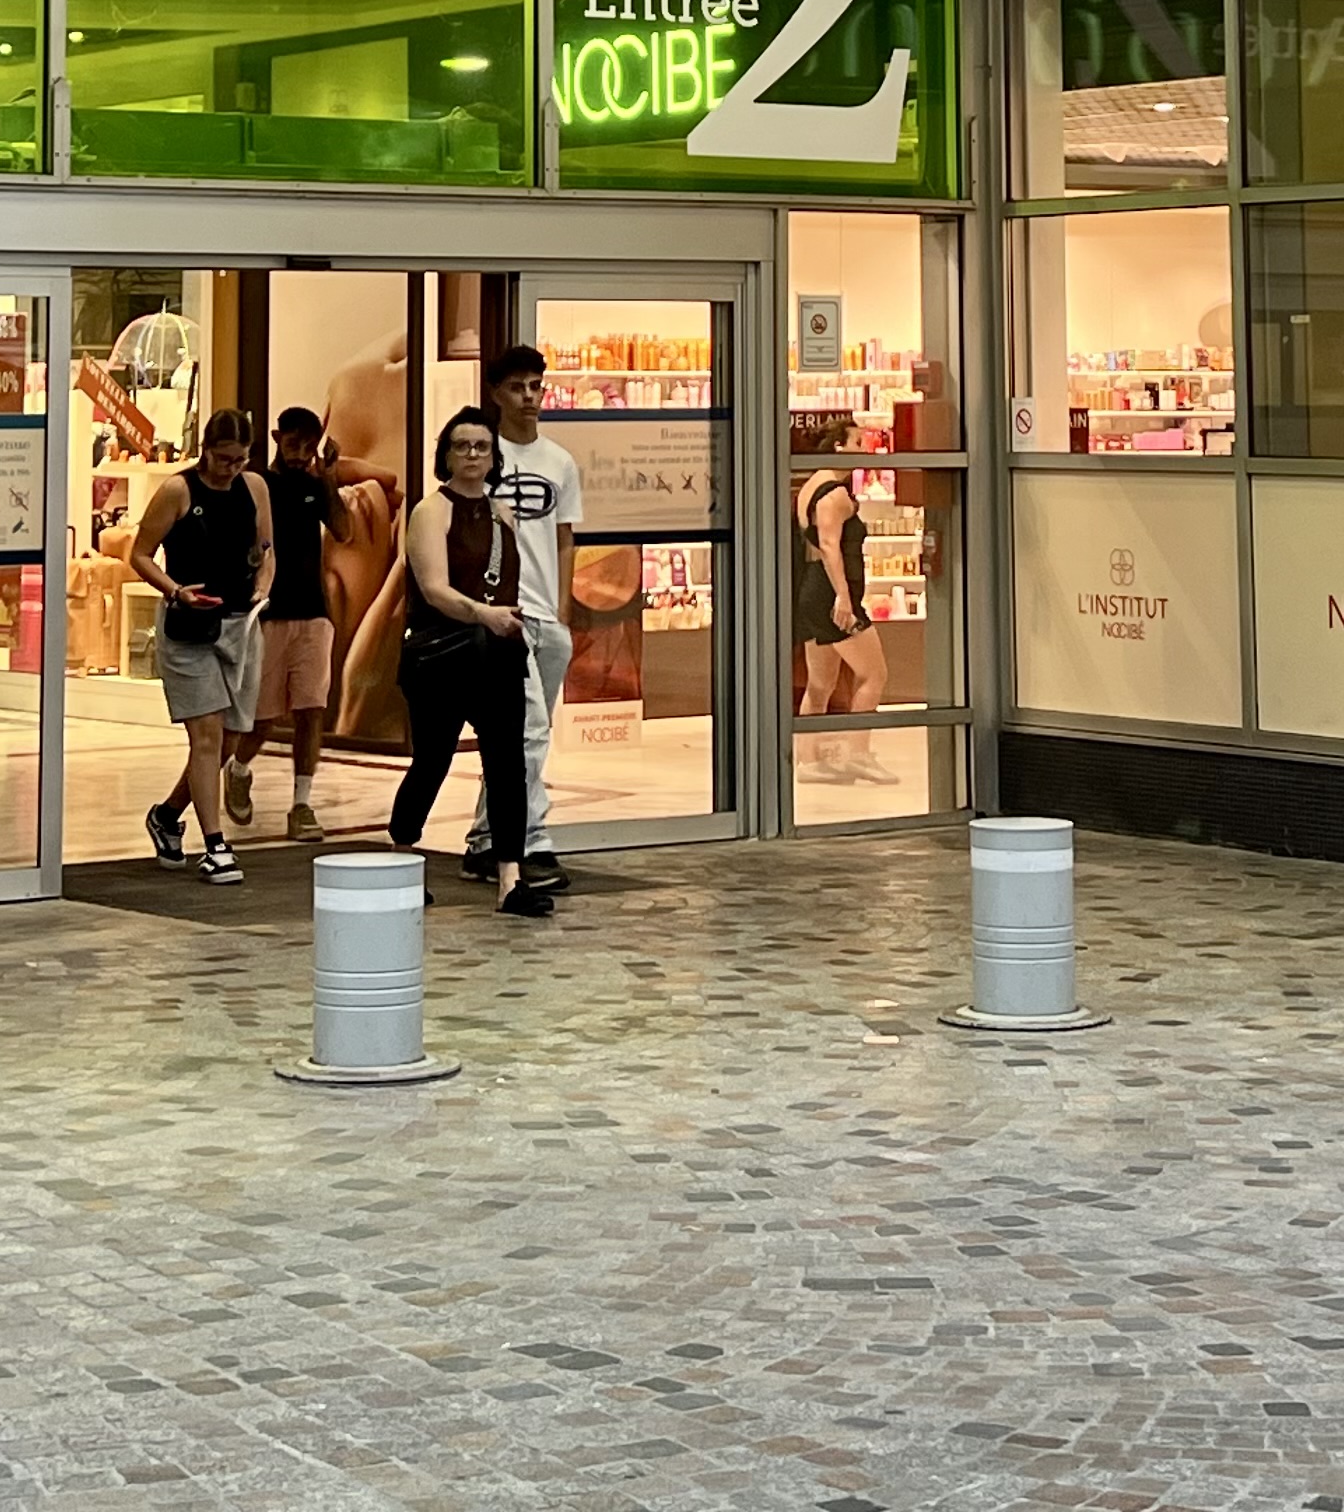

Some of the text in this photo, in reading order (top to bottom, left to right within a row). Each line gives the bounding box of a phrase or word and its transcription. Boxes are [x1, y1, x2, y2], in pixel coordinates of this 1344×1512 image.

[1077, 592, 1169, 620] L'INSTITUT
[1101, 620, 1146, 640] NOCIBÉ
[581, 722, 629, 743] NOCIBÉ
